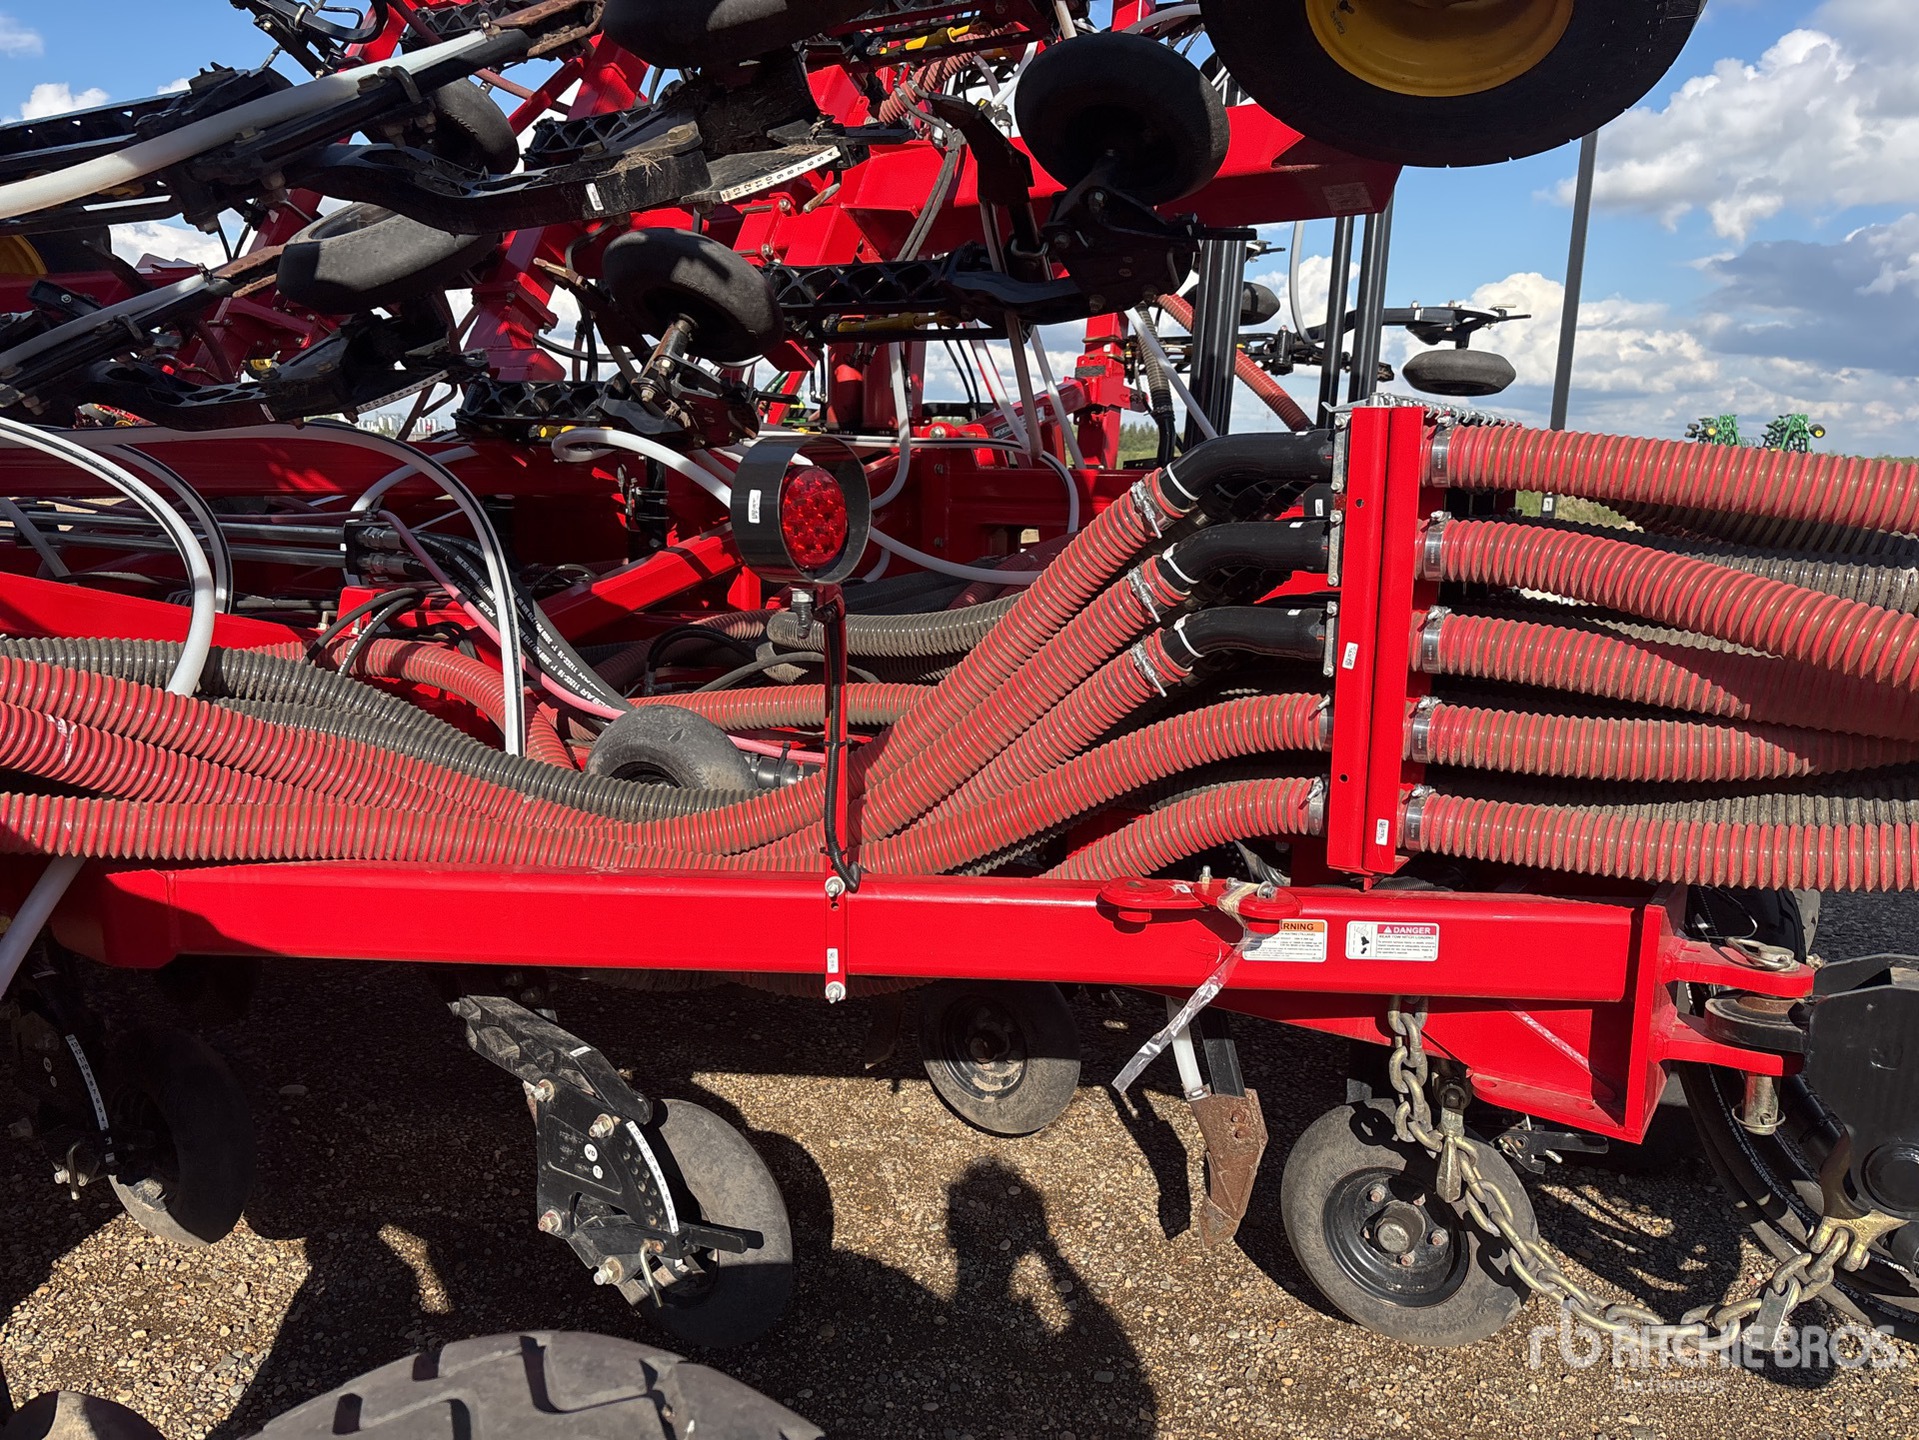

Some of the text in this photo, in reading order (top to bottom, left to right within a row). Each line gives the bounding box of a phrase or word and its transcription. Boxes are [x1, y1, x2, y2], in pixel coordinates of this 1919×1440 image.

[732, 187, 741, 197] 13
[743, 183, 752, 193] 12
[755, 180, 763, 188] 11
[765, 176, 774, 186] 10
[1280, 922, 1314, 930] RNING
[1393, 926, 1431, 934] DANGER
[633, 1129, 641, 1137] 13
[661, 1183, 666, 1191] 7
